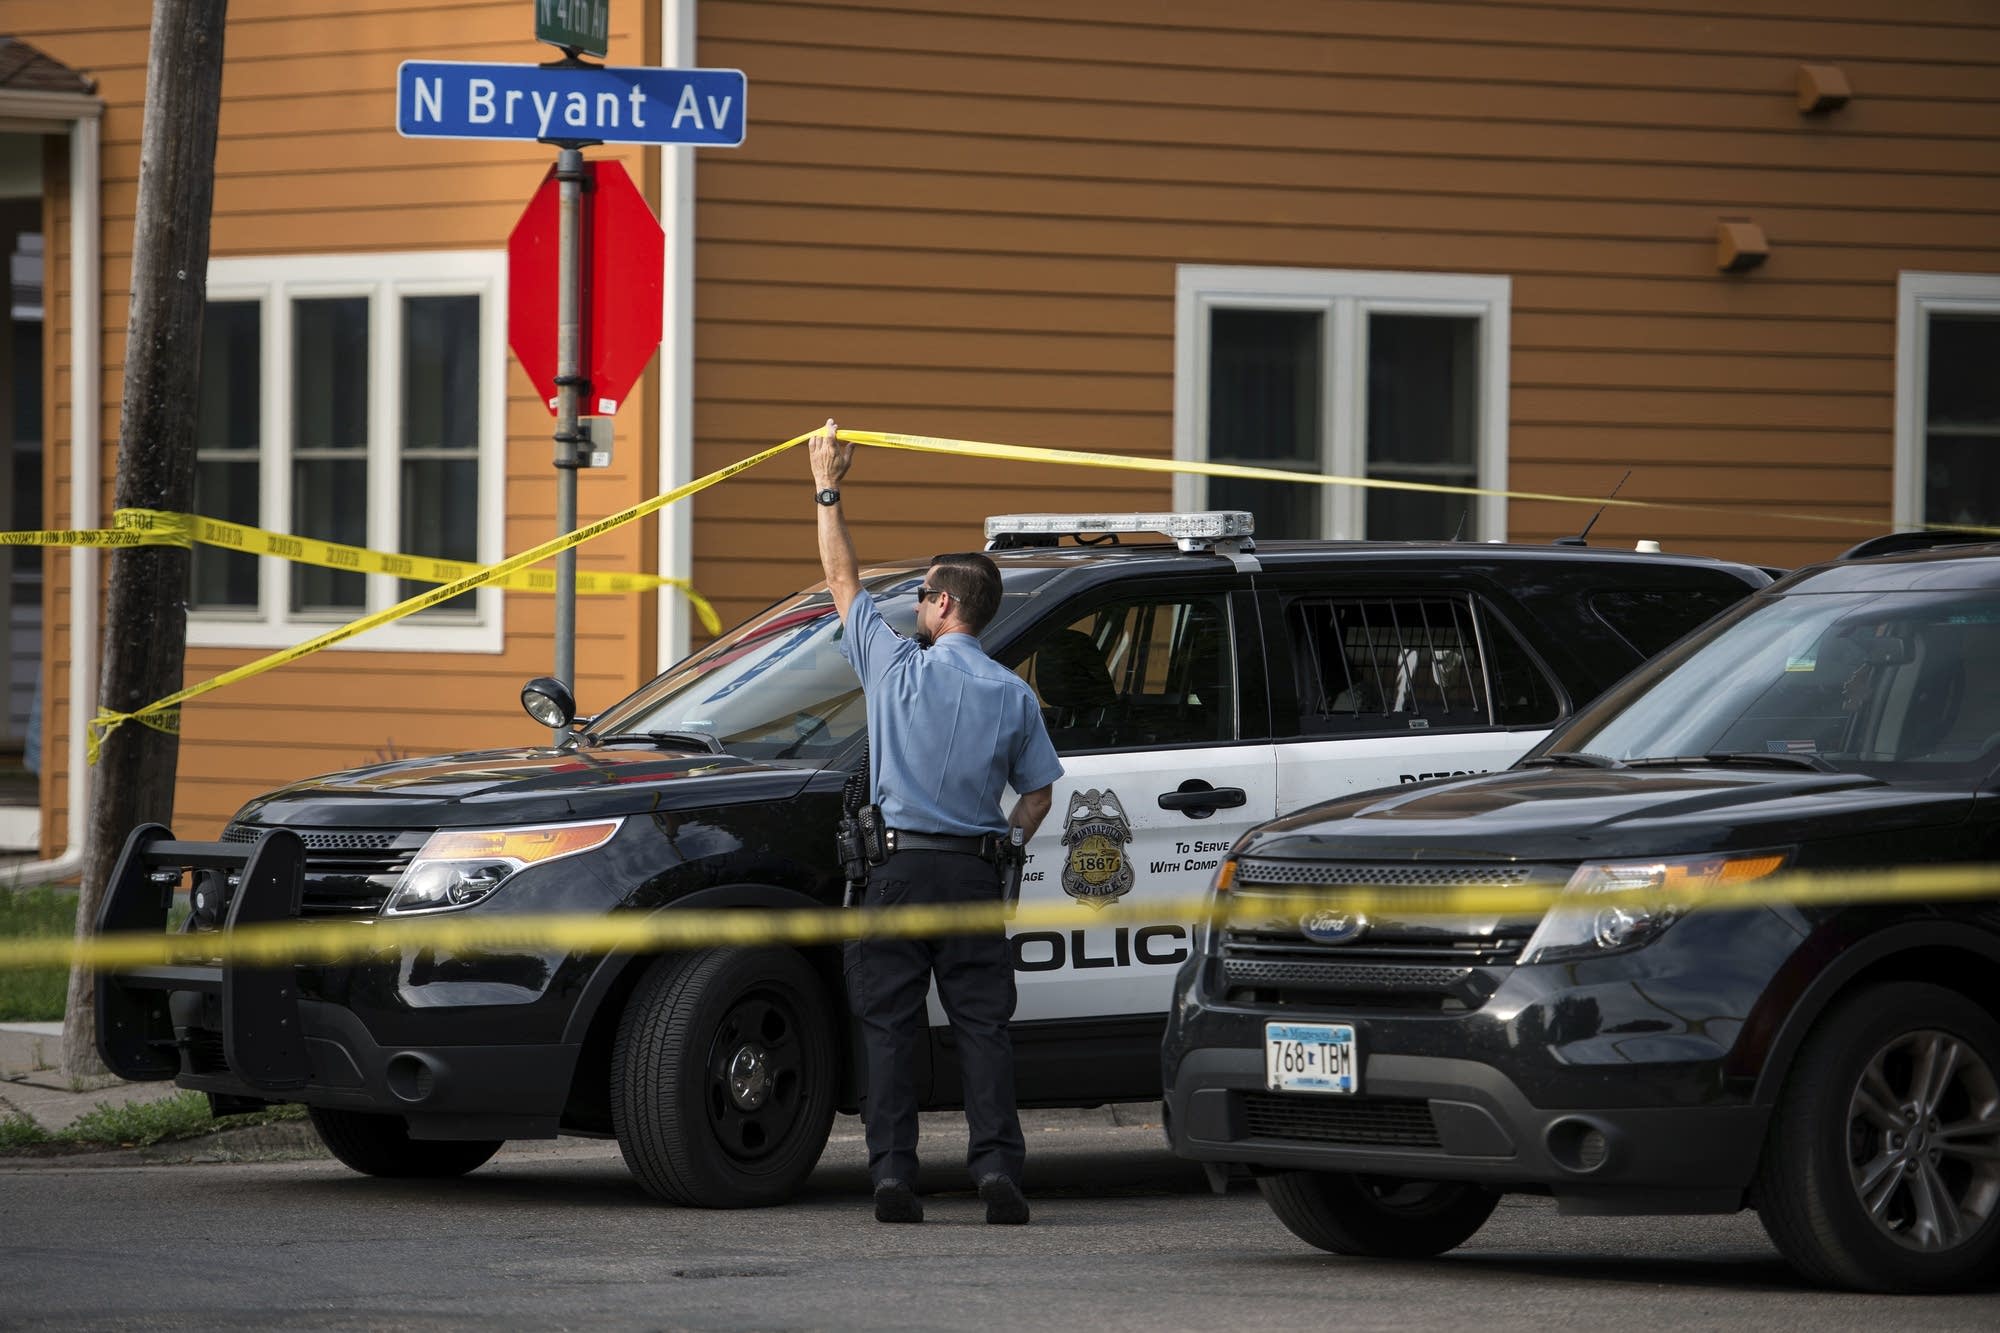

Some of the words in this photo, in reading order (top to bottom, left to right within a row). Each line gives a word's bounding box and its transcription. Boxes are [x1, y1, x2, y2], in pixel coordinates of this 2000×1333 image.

[414, 77, 442, 123] N
[468, 78, 647, 138] Bryant
[671, 84, 732, 130] Av
[1072, 823, 1122, 843] MINNEAPOLIS
[1080, 858, 1115, 871] 1867
[1310, 909, 1349, 931] Ford
[1011, 923, 1197, 972] OLIC
[1273, 1041, 1305, 1073] 768
[1318, 1043, 1351, 1075] TBM
